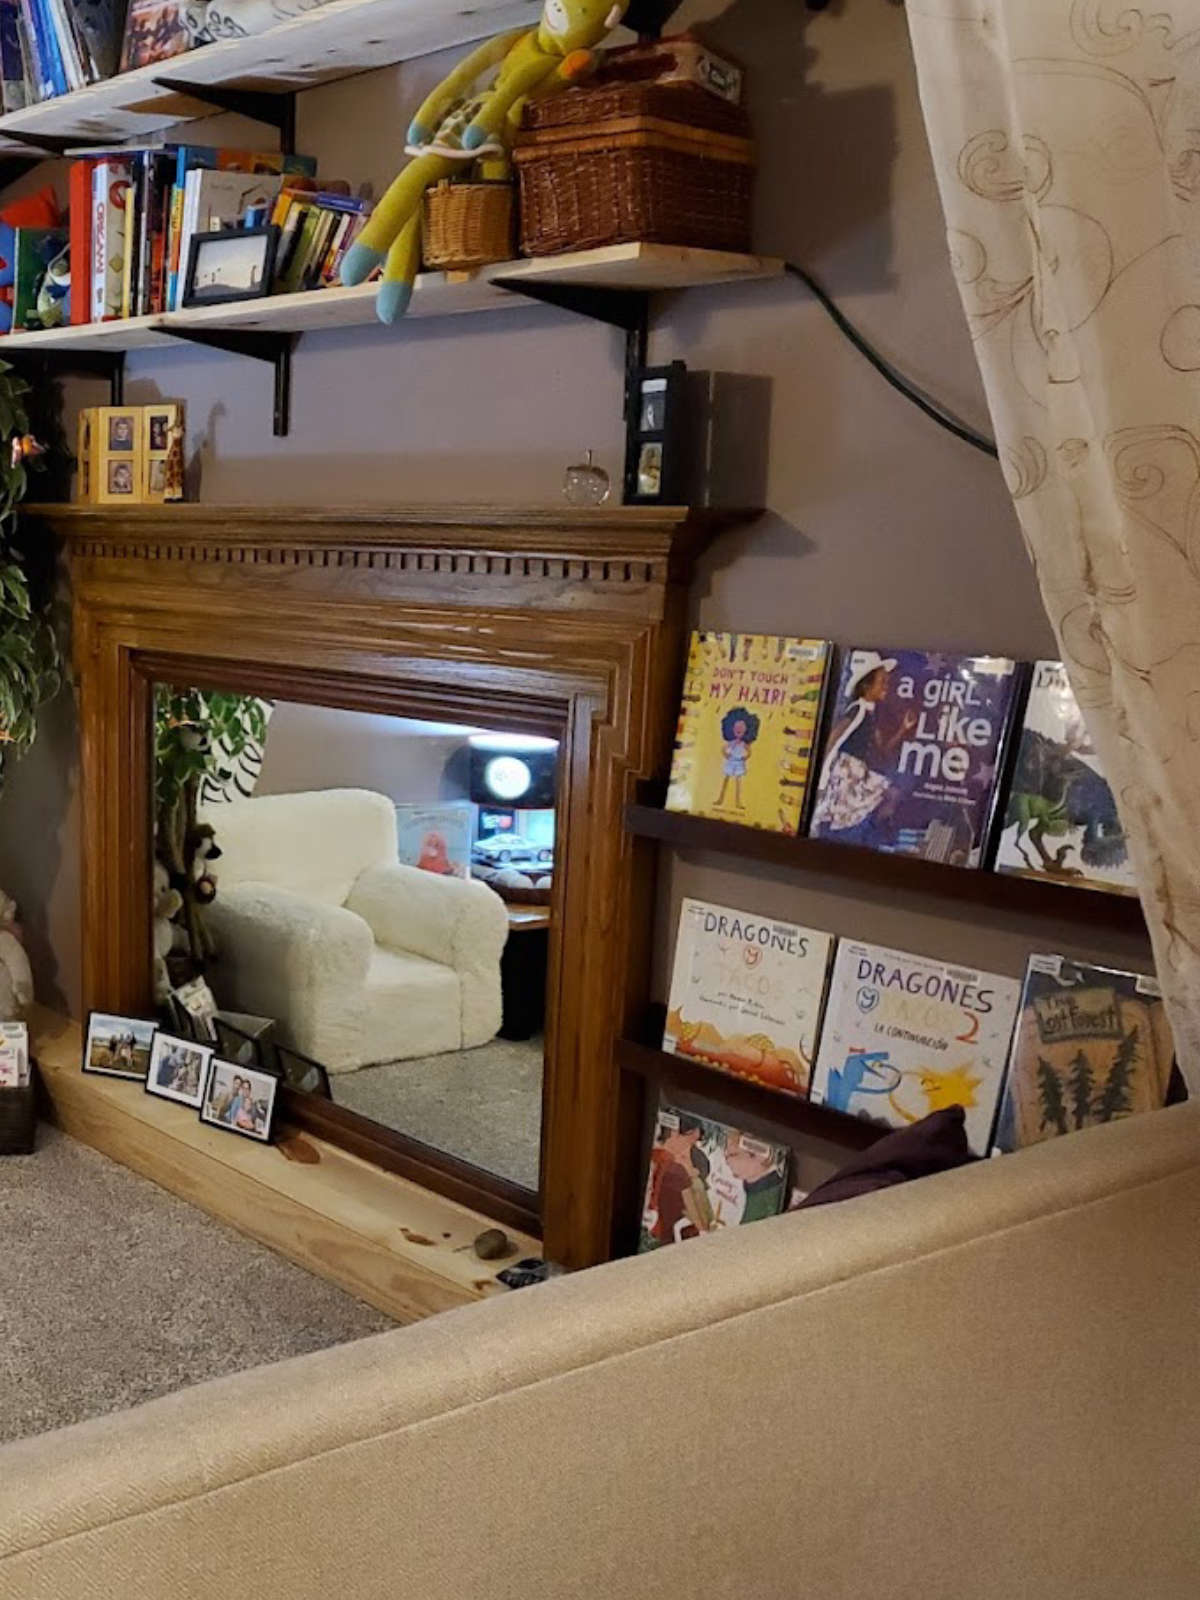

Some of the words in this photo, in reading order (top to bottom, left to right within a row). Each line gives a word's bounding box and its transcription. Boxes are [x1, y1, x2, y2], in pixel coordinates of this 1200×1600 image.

[709, 682, 733, 698] MY
[751, 671, 788, 684] TOUCH
[897, 741, 970, 782] me
[704, 912, 809, 958] DRAGONES
[857, 958, 995, 1014] DRAGONES
